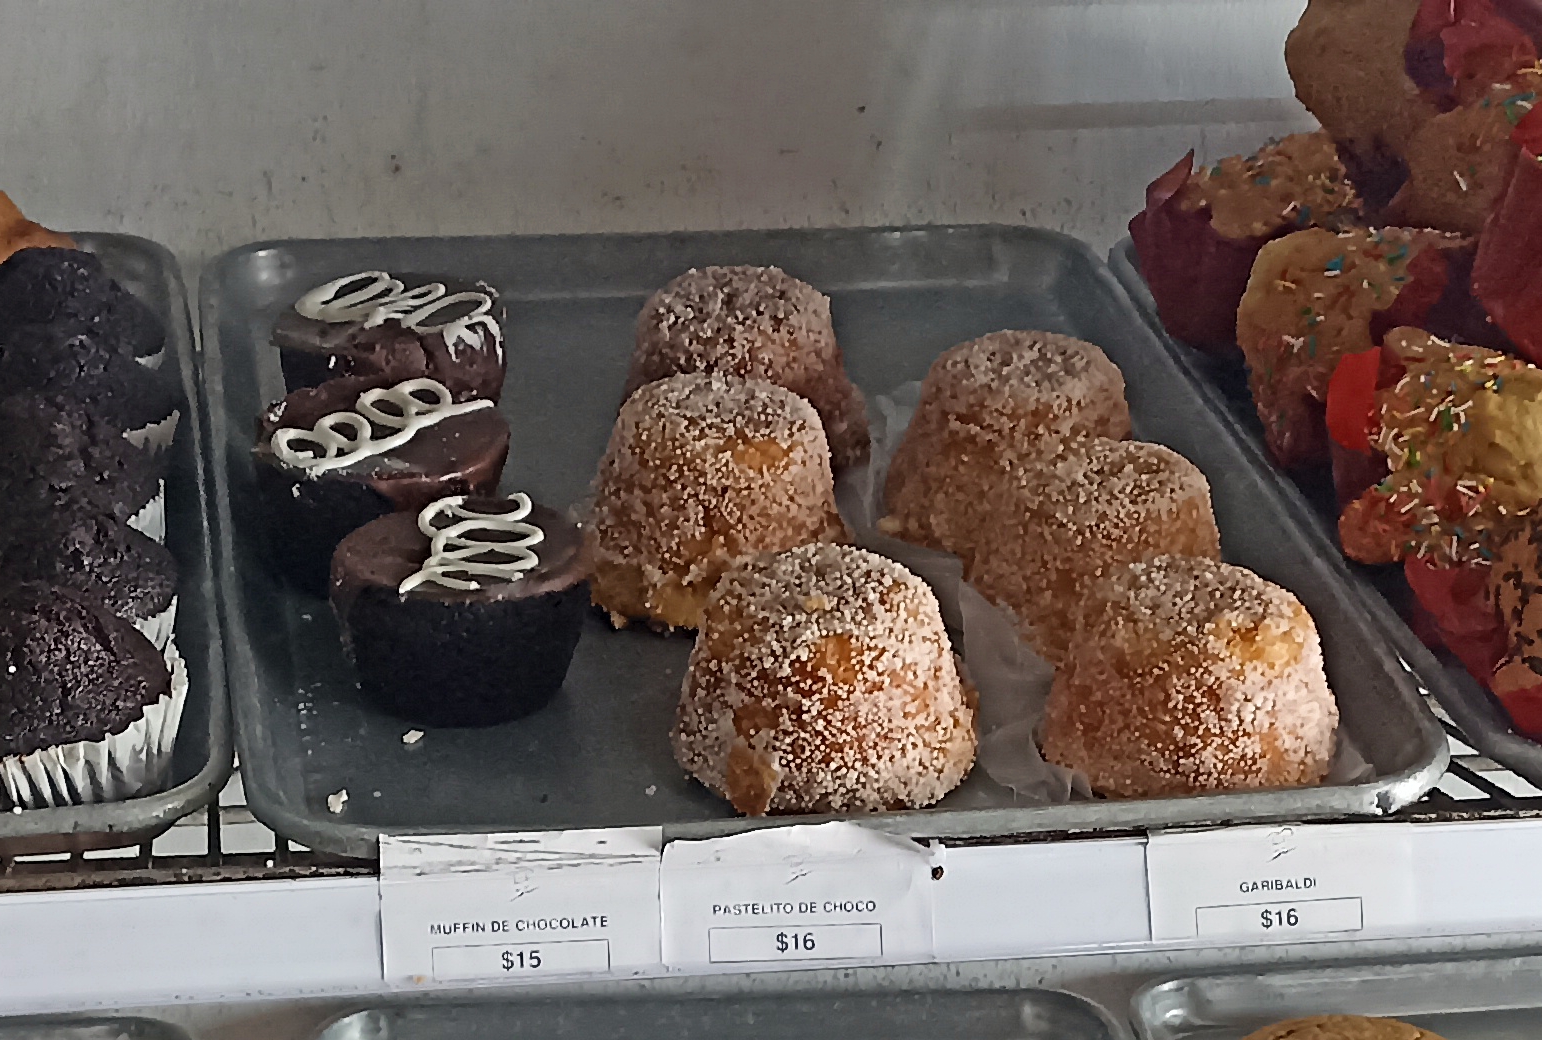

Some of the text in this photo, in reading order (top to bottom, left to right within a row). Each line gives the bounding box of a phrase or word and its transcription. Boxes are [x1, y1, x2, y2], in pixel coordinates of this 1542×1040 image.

[1239, 877, 1316, 893] GARIBALDI
[712, 900, 877, 915] PASTELITO DE CHOCO
[430, 915, 608, 935] MUFFIN DE CHOCOLATE
[1260, 908, 1299, 929] $16
[776, 931, 816, 953] $16
[501, 950, 542, 971] $15
